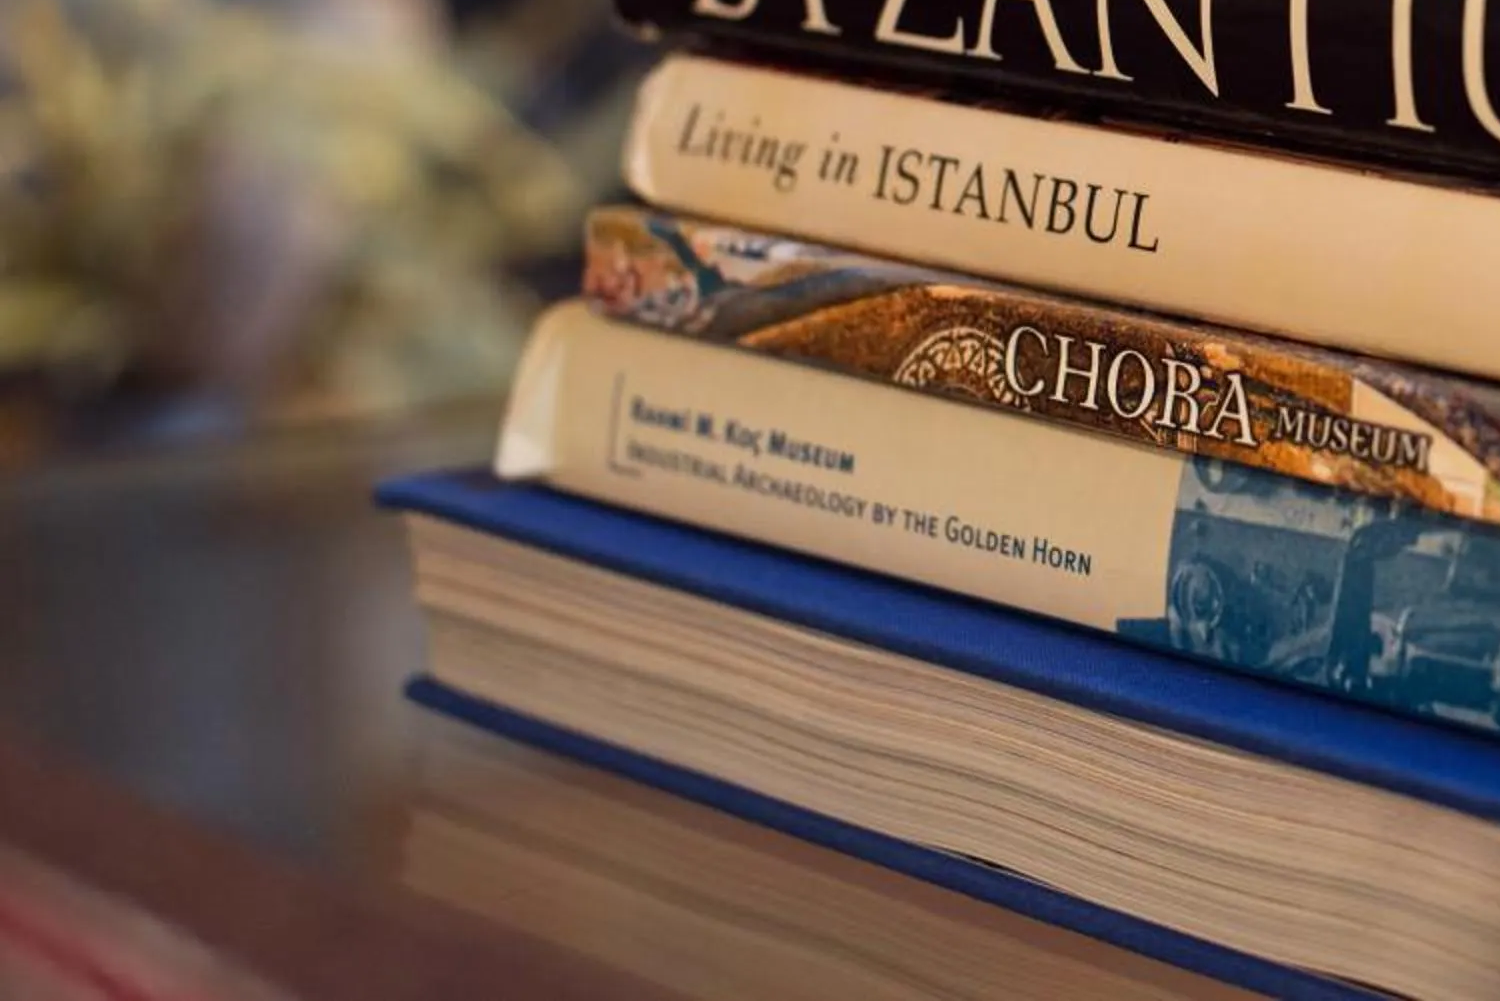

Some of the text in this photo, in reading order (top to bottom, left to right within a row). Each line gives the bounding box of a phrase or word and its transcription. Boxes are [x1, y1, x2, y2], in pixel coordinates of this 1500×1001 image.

[675, 103, 1159, 253] Living in ISTANBUL
[1005, 325, 1432, 472] CHORA MUSEUM
[732, 463, 868, 519] ARCHAEOLOGY
[872, 502, 897, 527] BY
[904, 509, 938, 537] THE
[945, 515, 1026, 560] GOLDEN
[1032, 537, 1092, 576] HORN
